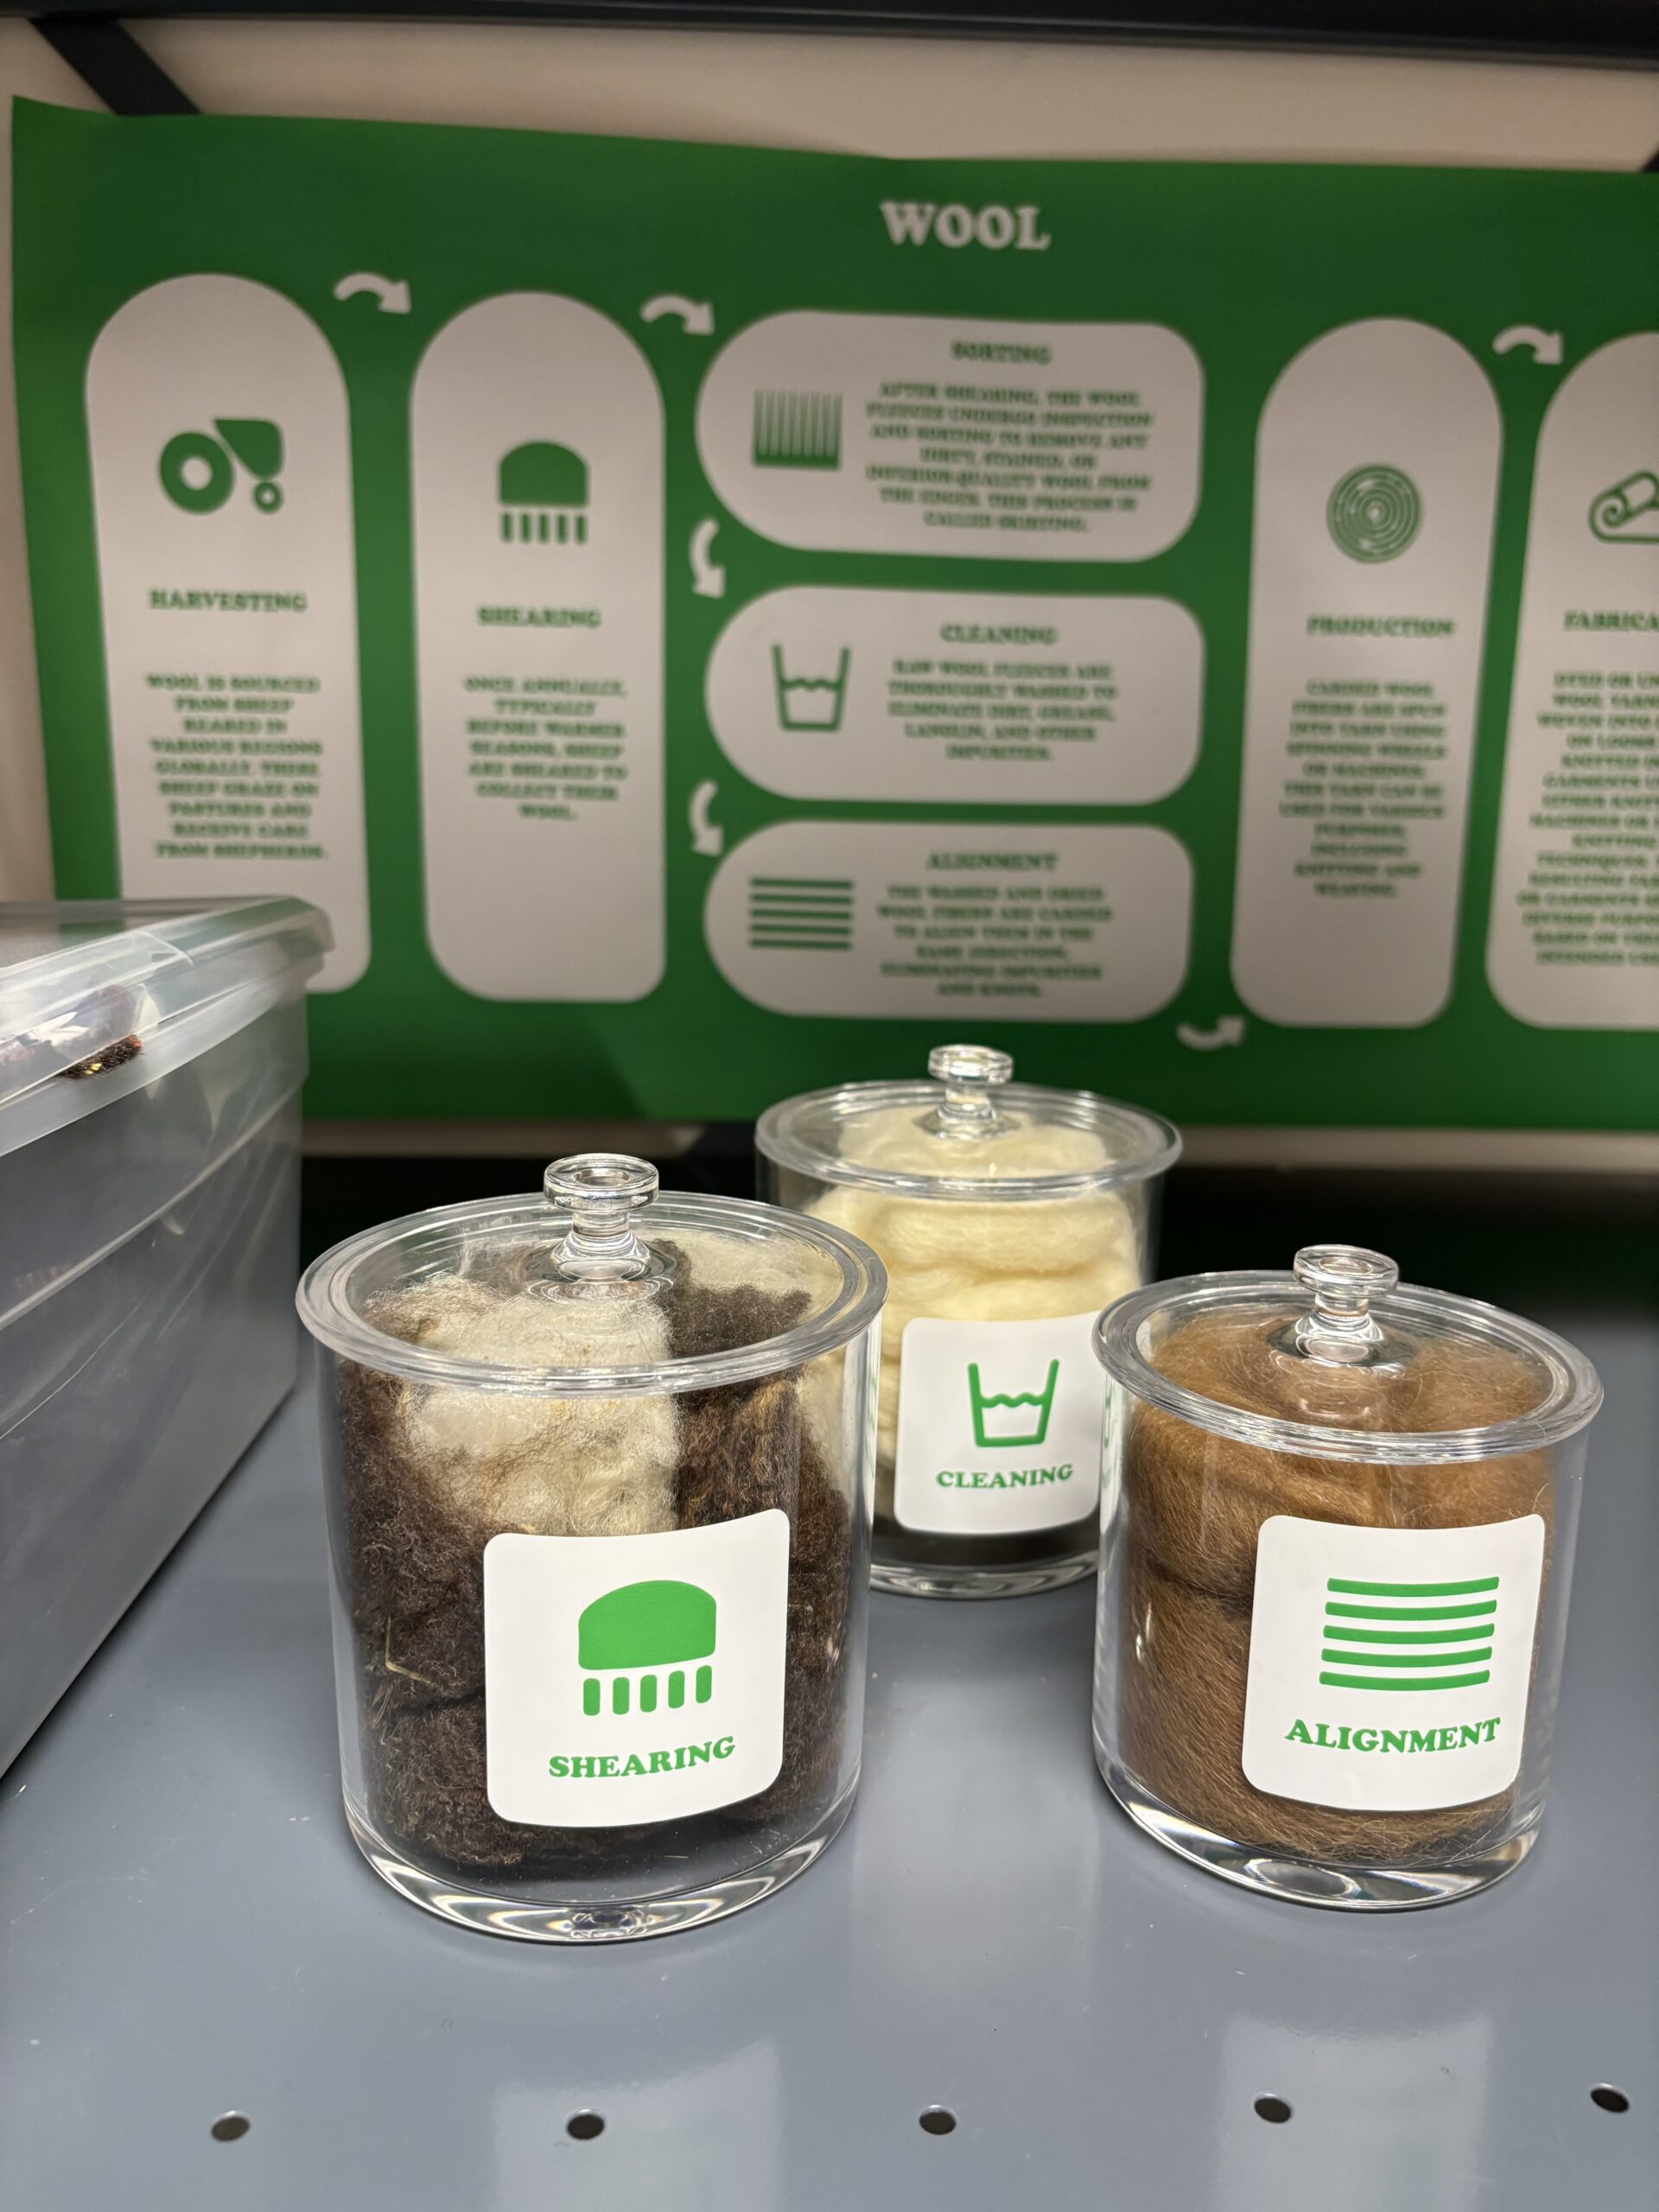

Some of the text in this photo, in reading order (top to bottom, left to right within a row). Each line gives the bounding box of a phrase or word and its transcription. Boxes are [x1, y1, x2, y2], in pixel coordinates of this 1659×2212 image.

[880, 200, 1052, 251] WOOL
[952, 341, 1051, 365] SORTING
[150, 591, 308, 612] HARVESTING
[478, 607, 601, 629] SHEARING
[1306, 616, 1454, 637] PRODUCTION
[940, 625, 1057, 645] CLEANING
[928, 852, 1058, 871] ALIGNMENT
[936, 1464, 1073, 1489] CLEANING
[1284, 1717, 1501, 1753] ALIGNMENT
[549, 1735, 735, 1778] SHEARING
